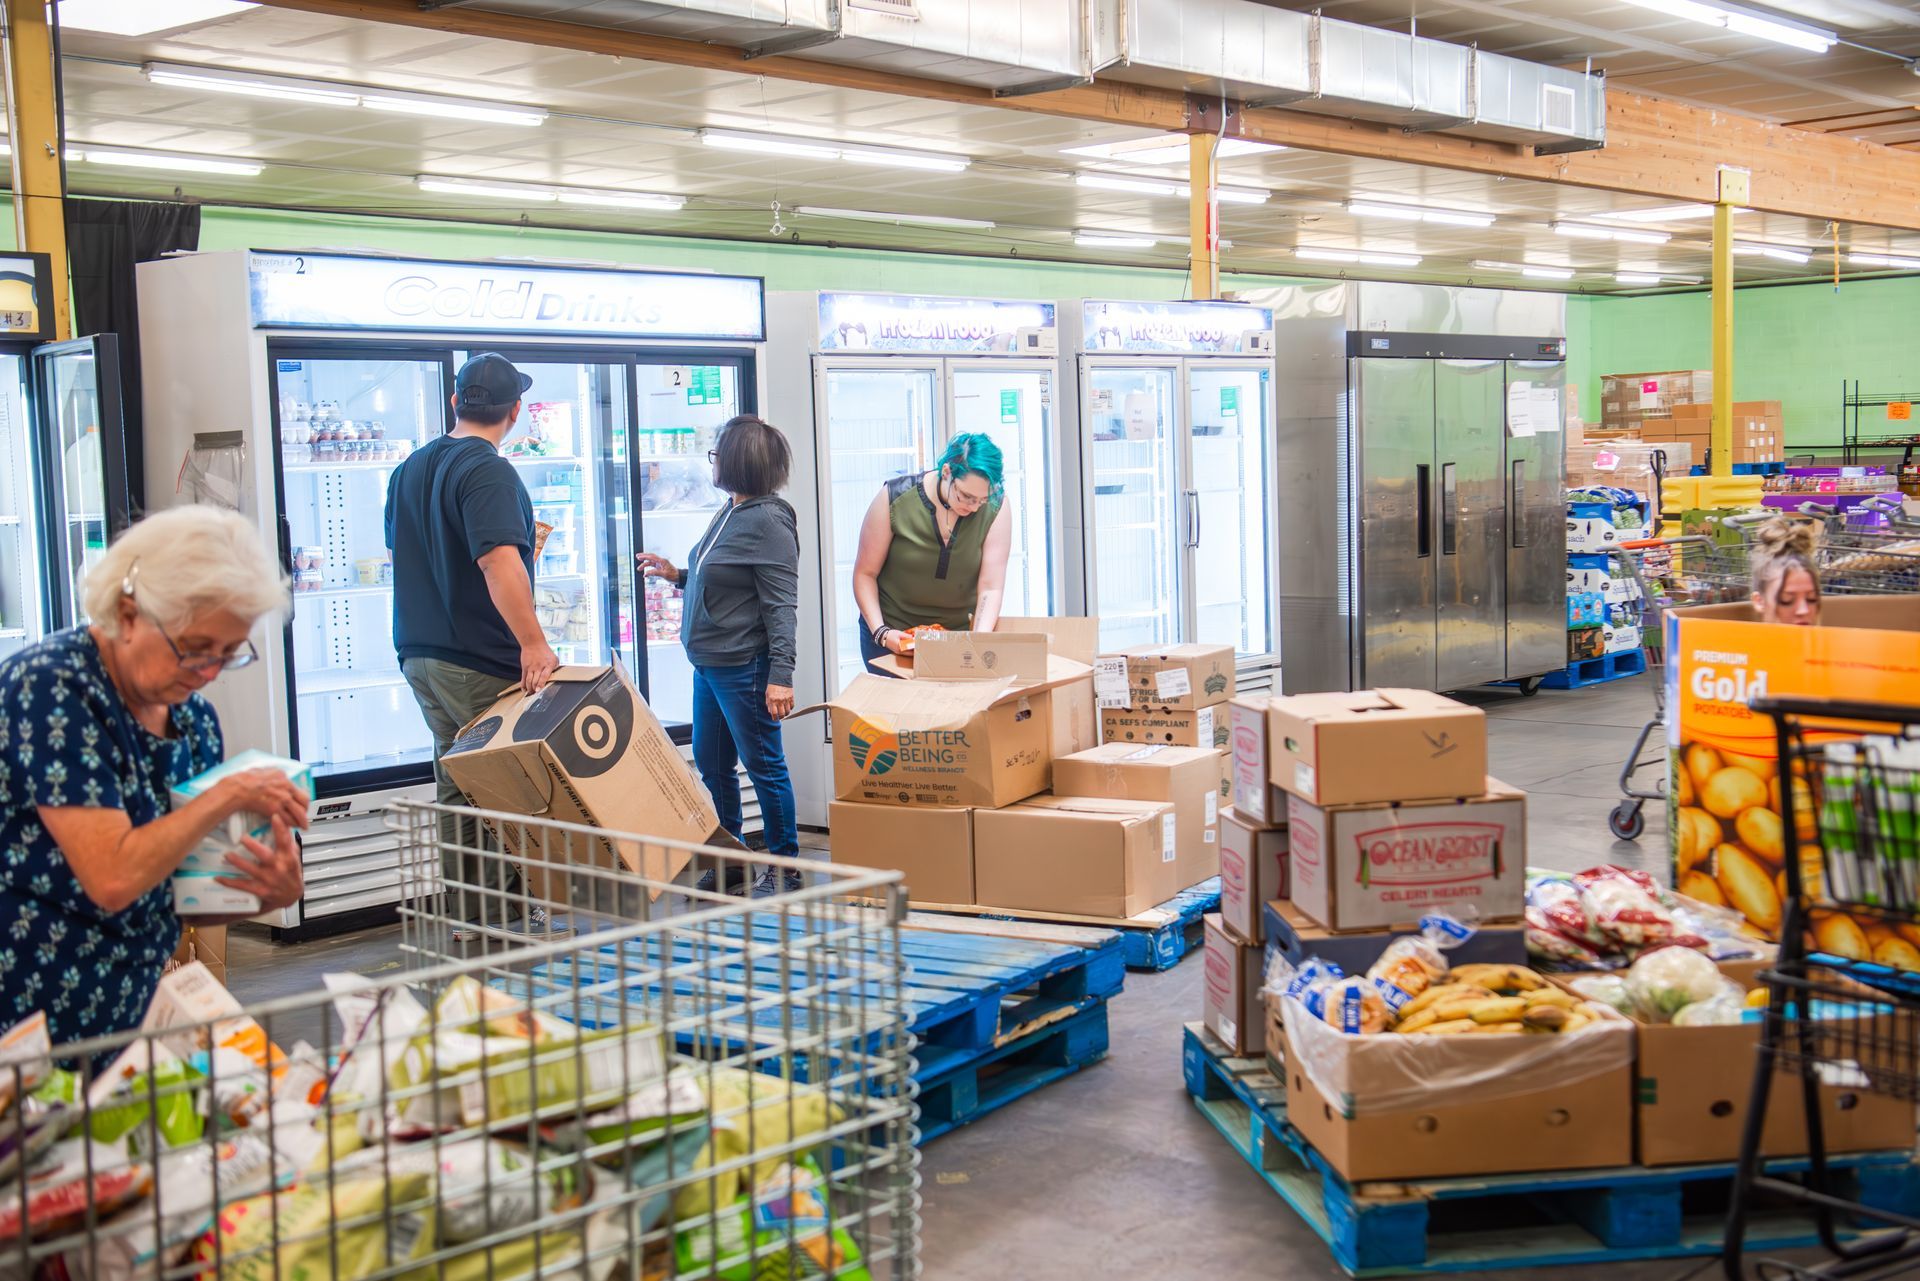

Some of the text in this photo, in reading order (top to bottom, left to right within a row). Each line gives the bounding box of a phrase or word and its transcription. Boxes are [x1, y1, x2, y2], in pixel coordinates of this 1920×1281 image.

[295, 256, 306, 275] 2
[384, 275, 664, 325] Cold Drinks
[672, 370, 681, 386] 2
[1693, 649, 1748, 665] PREMIUM
[1103, 662, 1118, 671] 220
[1691, 667, 1768, 704] Gold
[1138, 695, 1150, 703] OR
[1693, 702, 1754, 720] POTATOES
[1105, 717, 1117, 726] CA
[1142, 718, 1191, 728] COMPLIANT
[898, 729, 971, 748] BETTER
[900, 747, 955, 764] BEING
[548, 761, 567, 785] DOBLE
[564, 784, 583, 810] PARTE
[861, 779, 878, 787] Live
[915, 782, 931, 790] Live
[932, 783, 958, 792] Better.
[1370, 838, 1436, 866] OCEAN
[1380, 885, 1483, 902] CELERY HEARTS
